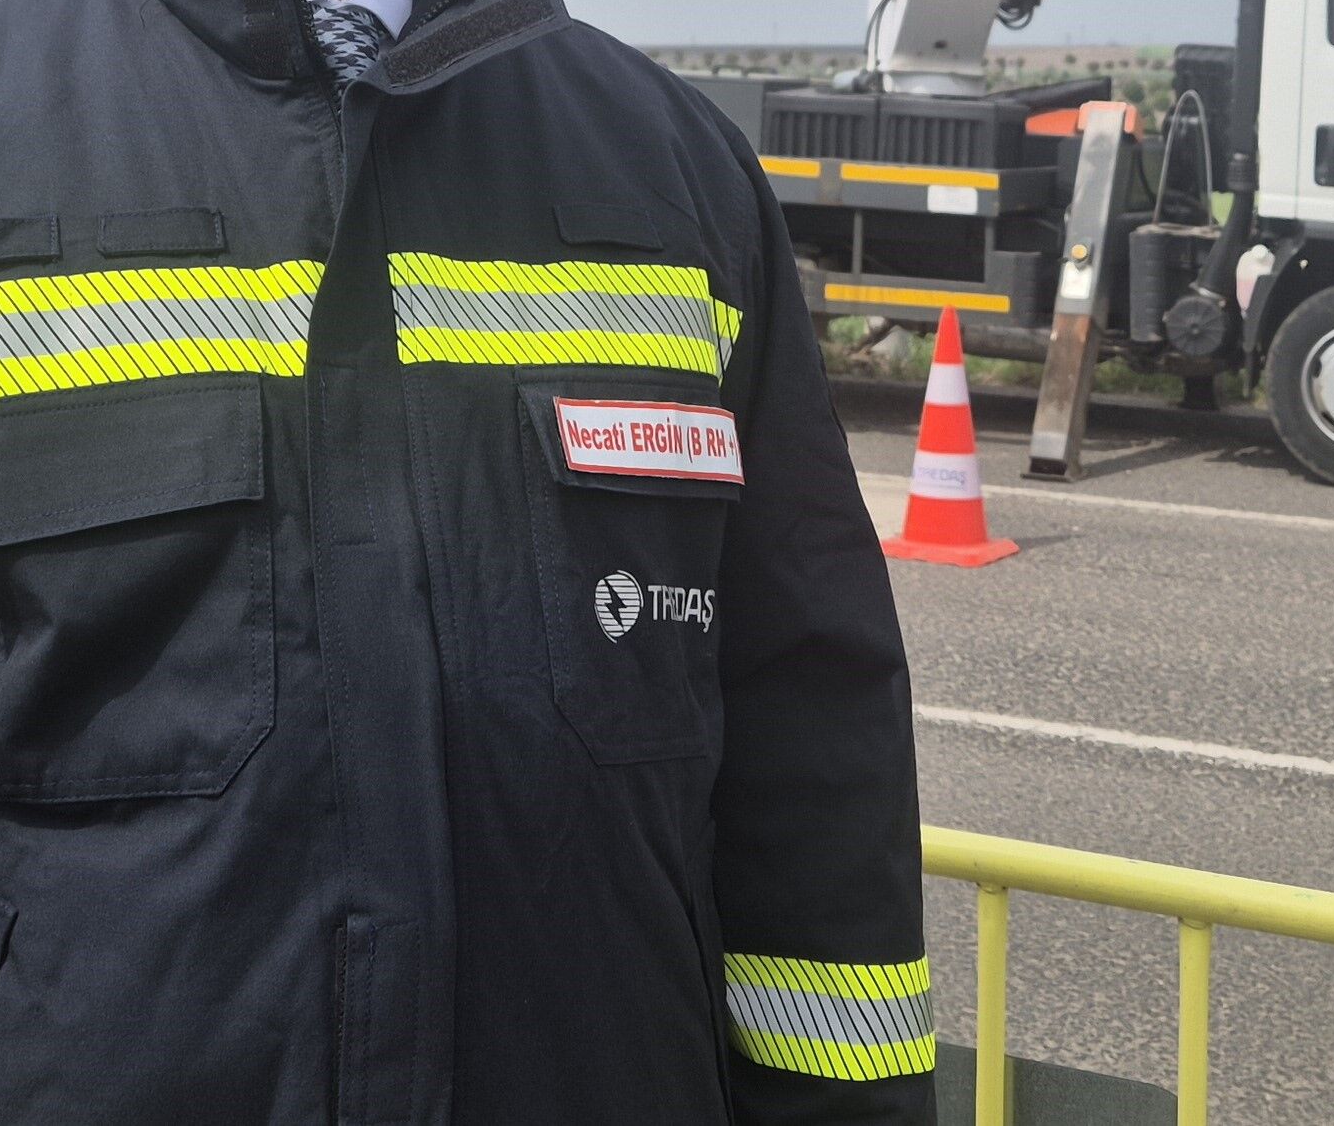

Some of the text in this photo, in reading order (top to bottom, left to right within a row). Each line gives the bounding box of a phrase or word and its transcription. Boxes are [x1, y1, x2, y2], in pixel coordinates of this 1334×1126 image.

[566, 419, 626, 451] Necati
[630, 416, 683, 454] ERGİN
[687, 425, 702, 463] (B
[706, 427, 727, 458] RH
